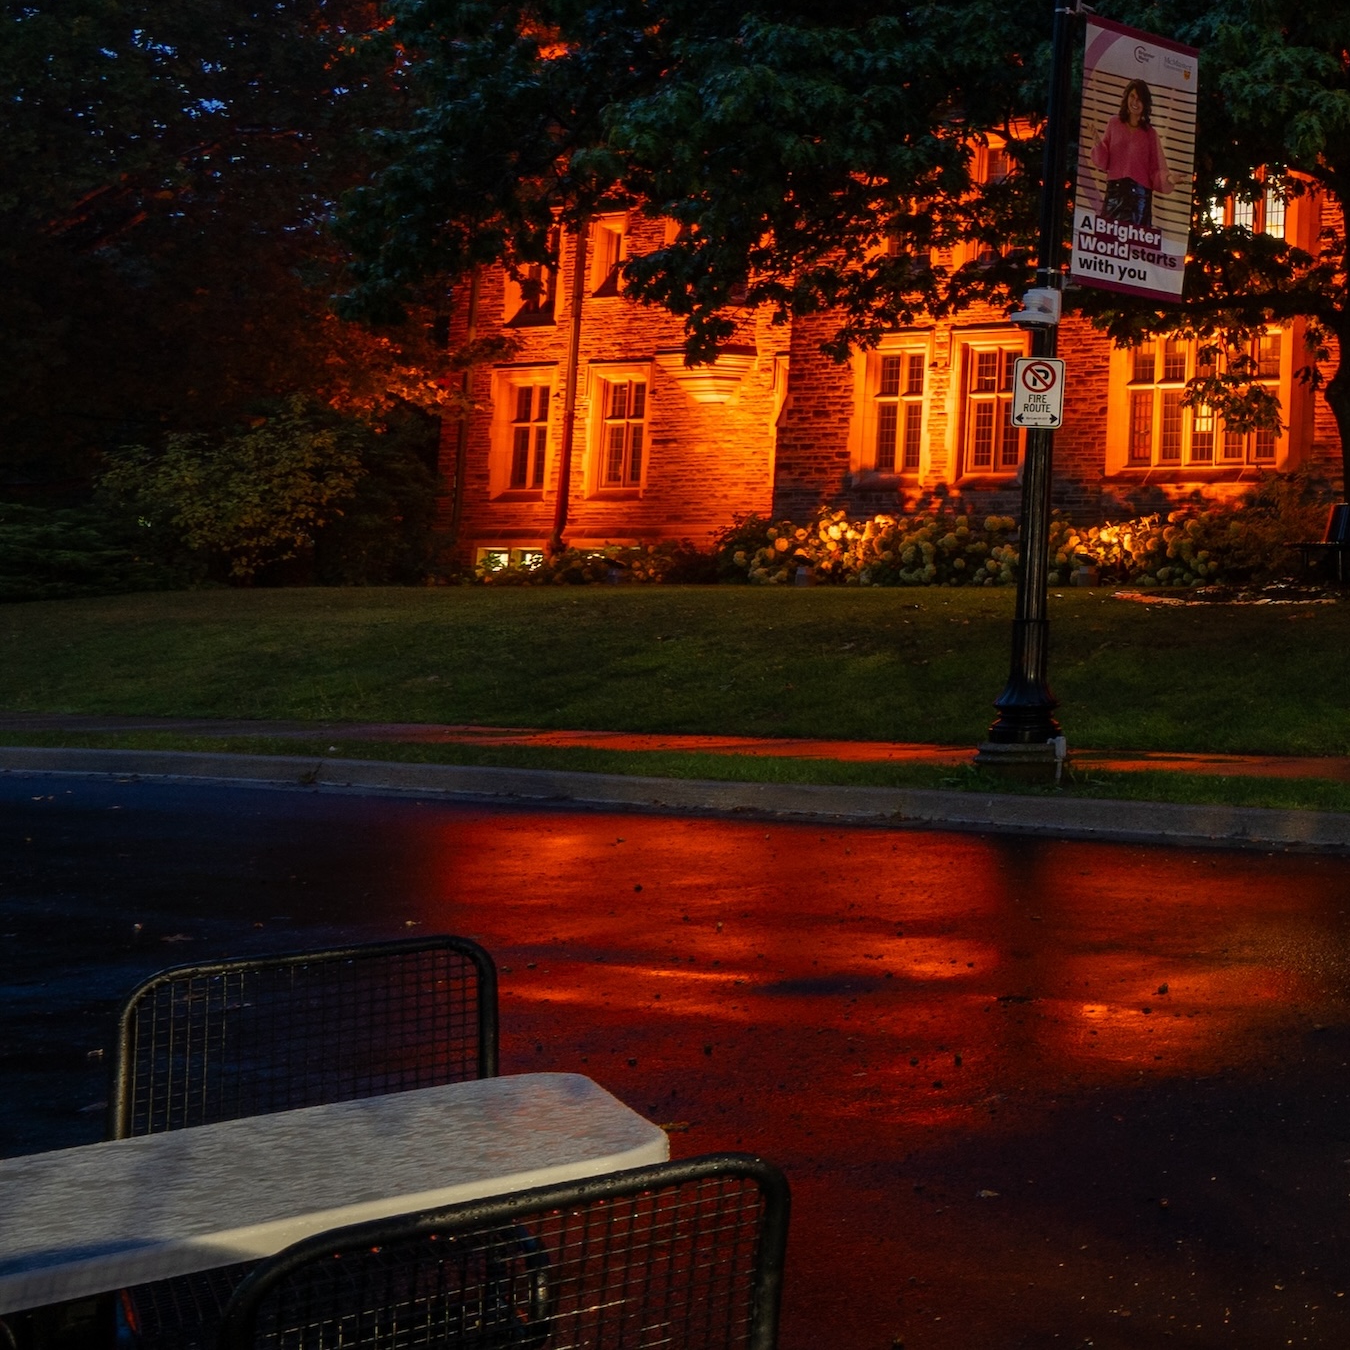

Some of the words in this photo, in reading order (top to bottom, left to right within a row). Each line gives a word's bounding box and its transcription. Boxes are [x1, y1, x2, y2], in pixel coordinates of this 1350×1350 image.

[1081, 216, 1092, 230] A
[1096, 217, 1161, 245] Brighter
[1080, 235, 1128, 258] World
[1132, 249, 1177, 267] starts
[1079, 257, 1114, 274] with
[1118, 266, 1147, 281] you
[1023, 403, 1051, 413] ROUTE
[1028, 394, 1047, 404] FIRE
